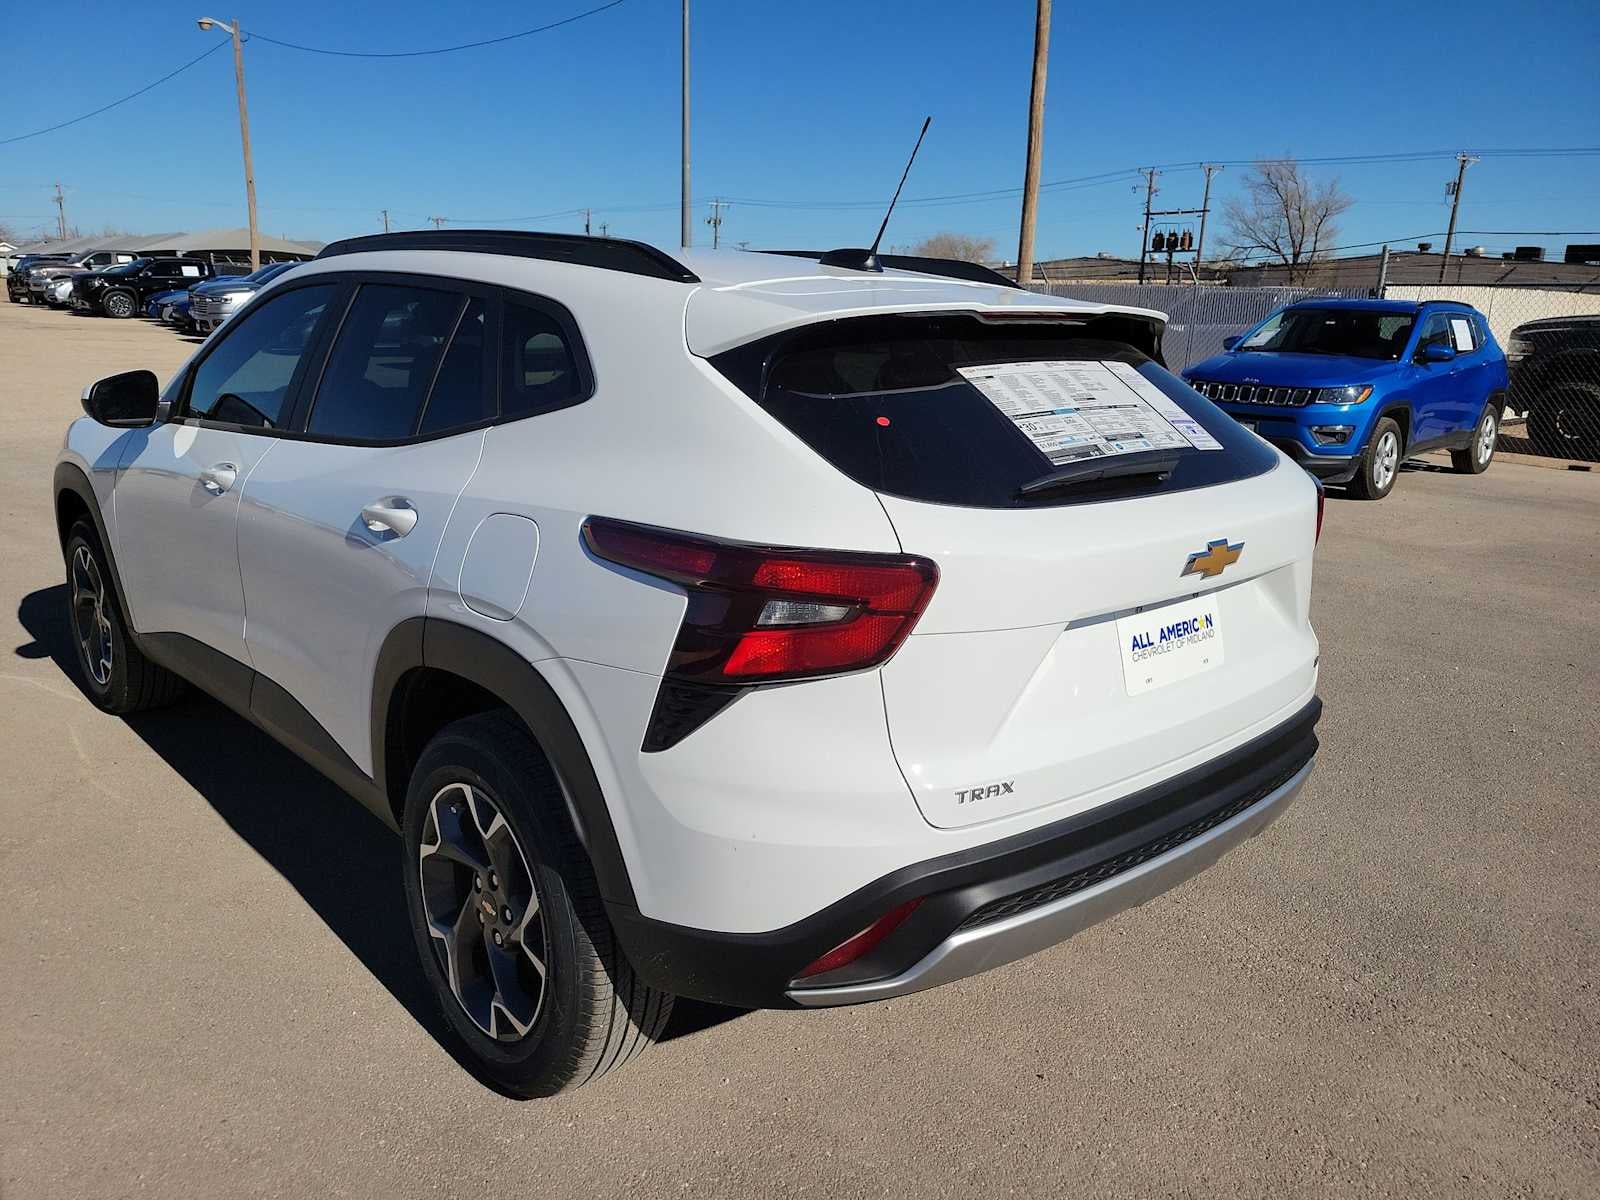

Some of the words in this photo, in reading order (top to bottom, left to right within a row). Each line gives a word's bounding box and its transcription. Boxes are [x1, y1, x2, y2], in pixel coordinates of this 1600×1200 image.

[1131, 632, 1155, 652] ALL
[1131, 641, 1174, 663] CHEVROLET
[1176, 638, 1186, 649] OF
[1186, 628, 1215, 645] MIDLAND
[954, 781, 1015, 804] TRAX
